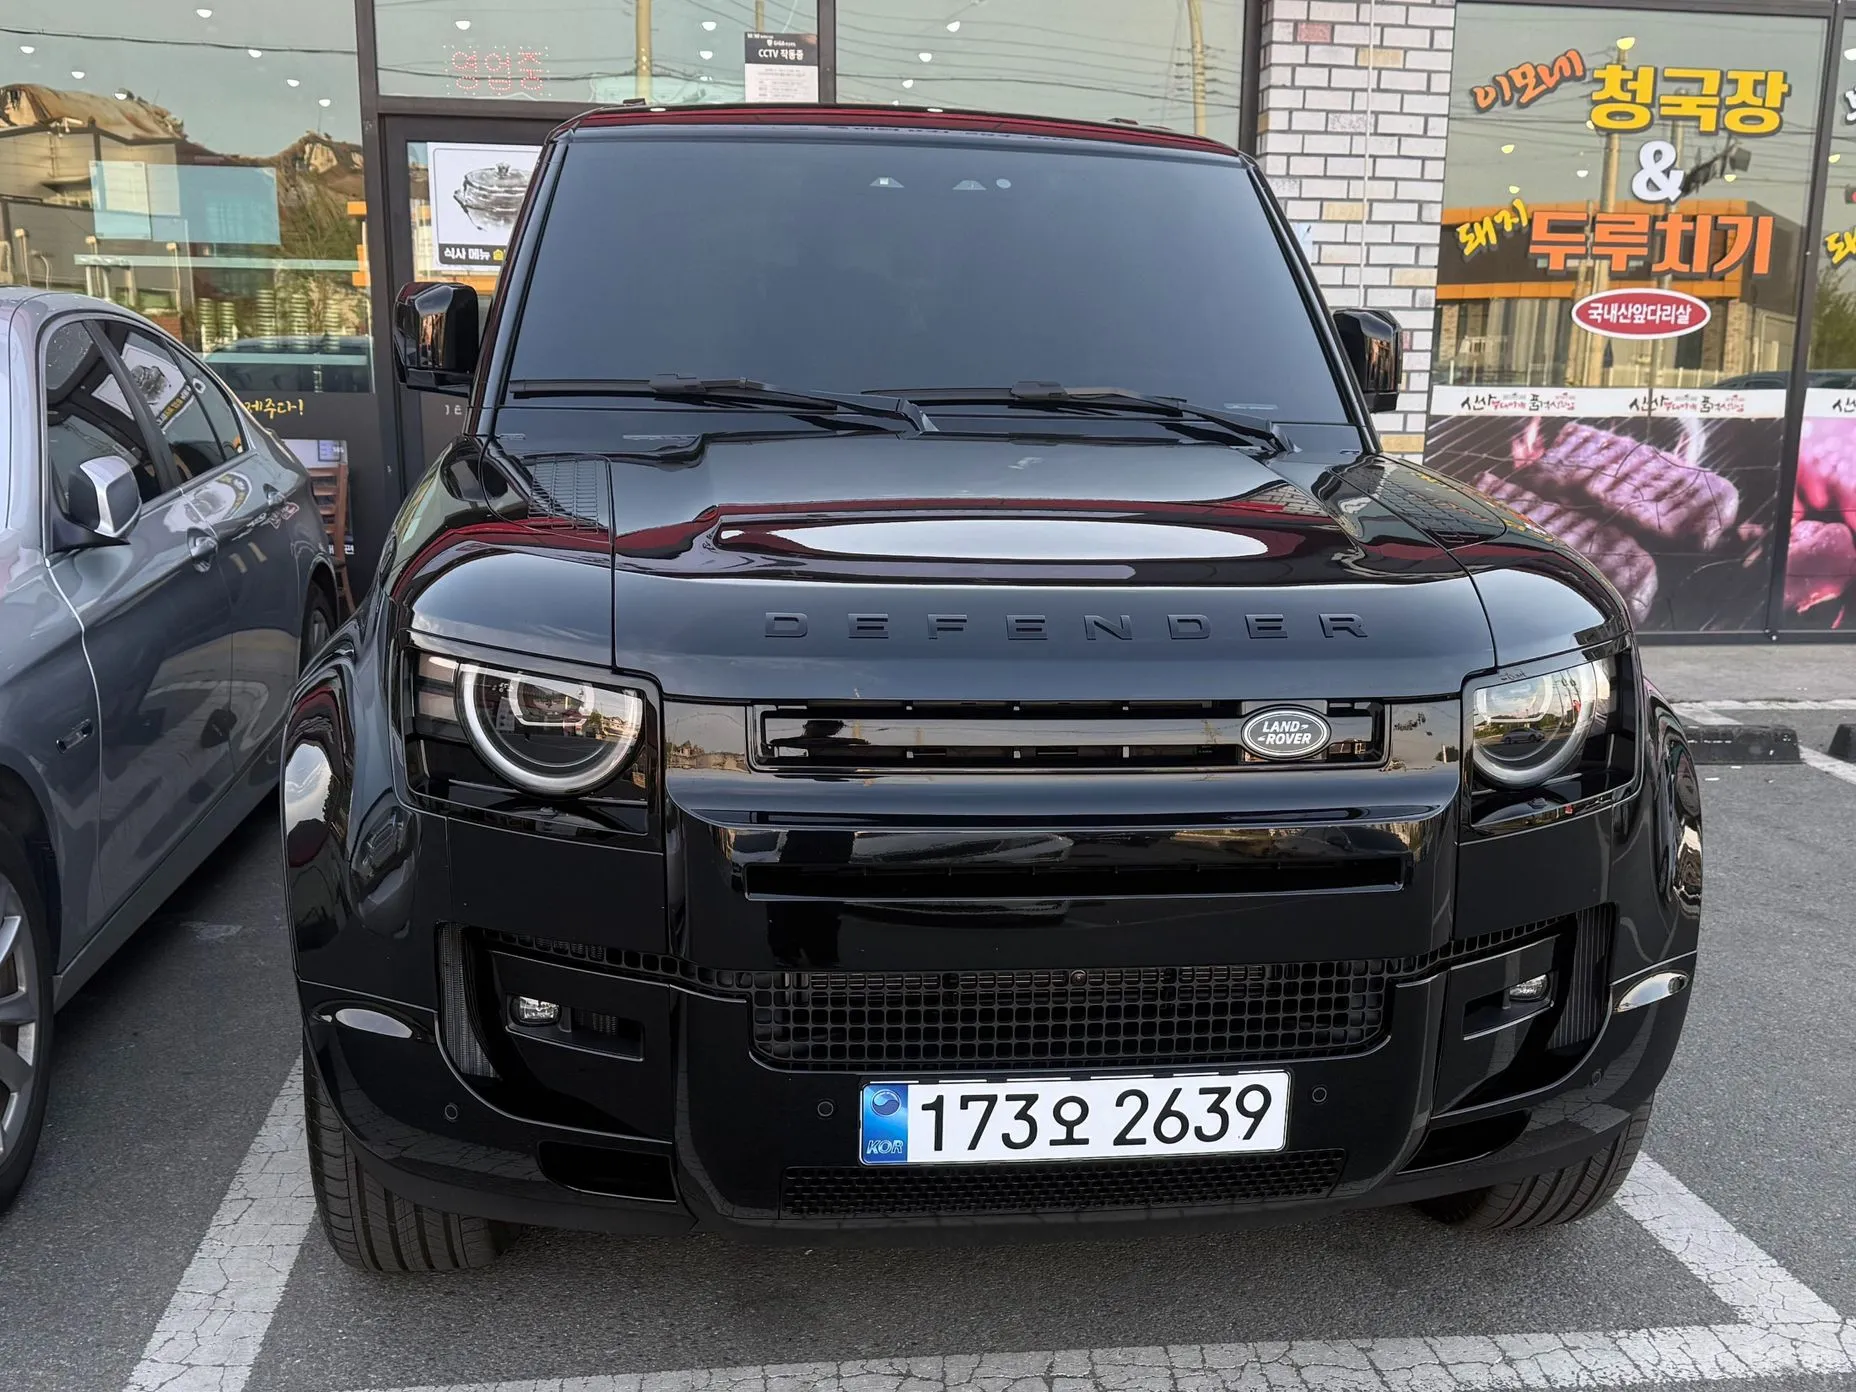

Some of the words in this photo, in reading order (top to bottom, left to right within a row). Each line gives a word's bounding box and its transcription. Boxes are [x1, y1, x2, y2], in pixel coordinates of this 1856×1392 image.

[451, 50, 545, 91] 영업중
[758, 48, 779, 59] CCTV
[780, 49, 804, 61] 작동중
[1590, 63, 1790, 135] 청국장
[1631, 139, 1686, 203] &
[444, 247, 466, 260] 식사
[468, 248, 491, 261] 메뉴
[1455, 198, 1529, 256] 돼지
[1528, 210, 1776, 275] 두루치기
[1588, 302, 1692, 325] 국내산앞다리살
[764, 611, 1369, 641] DEFENDER
[920, 1092, 1091, 1152] 173오
[1113, 1083, 1273, 1147] 2639
[866, 1139, 904, 1155] KOR
